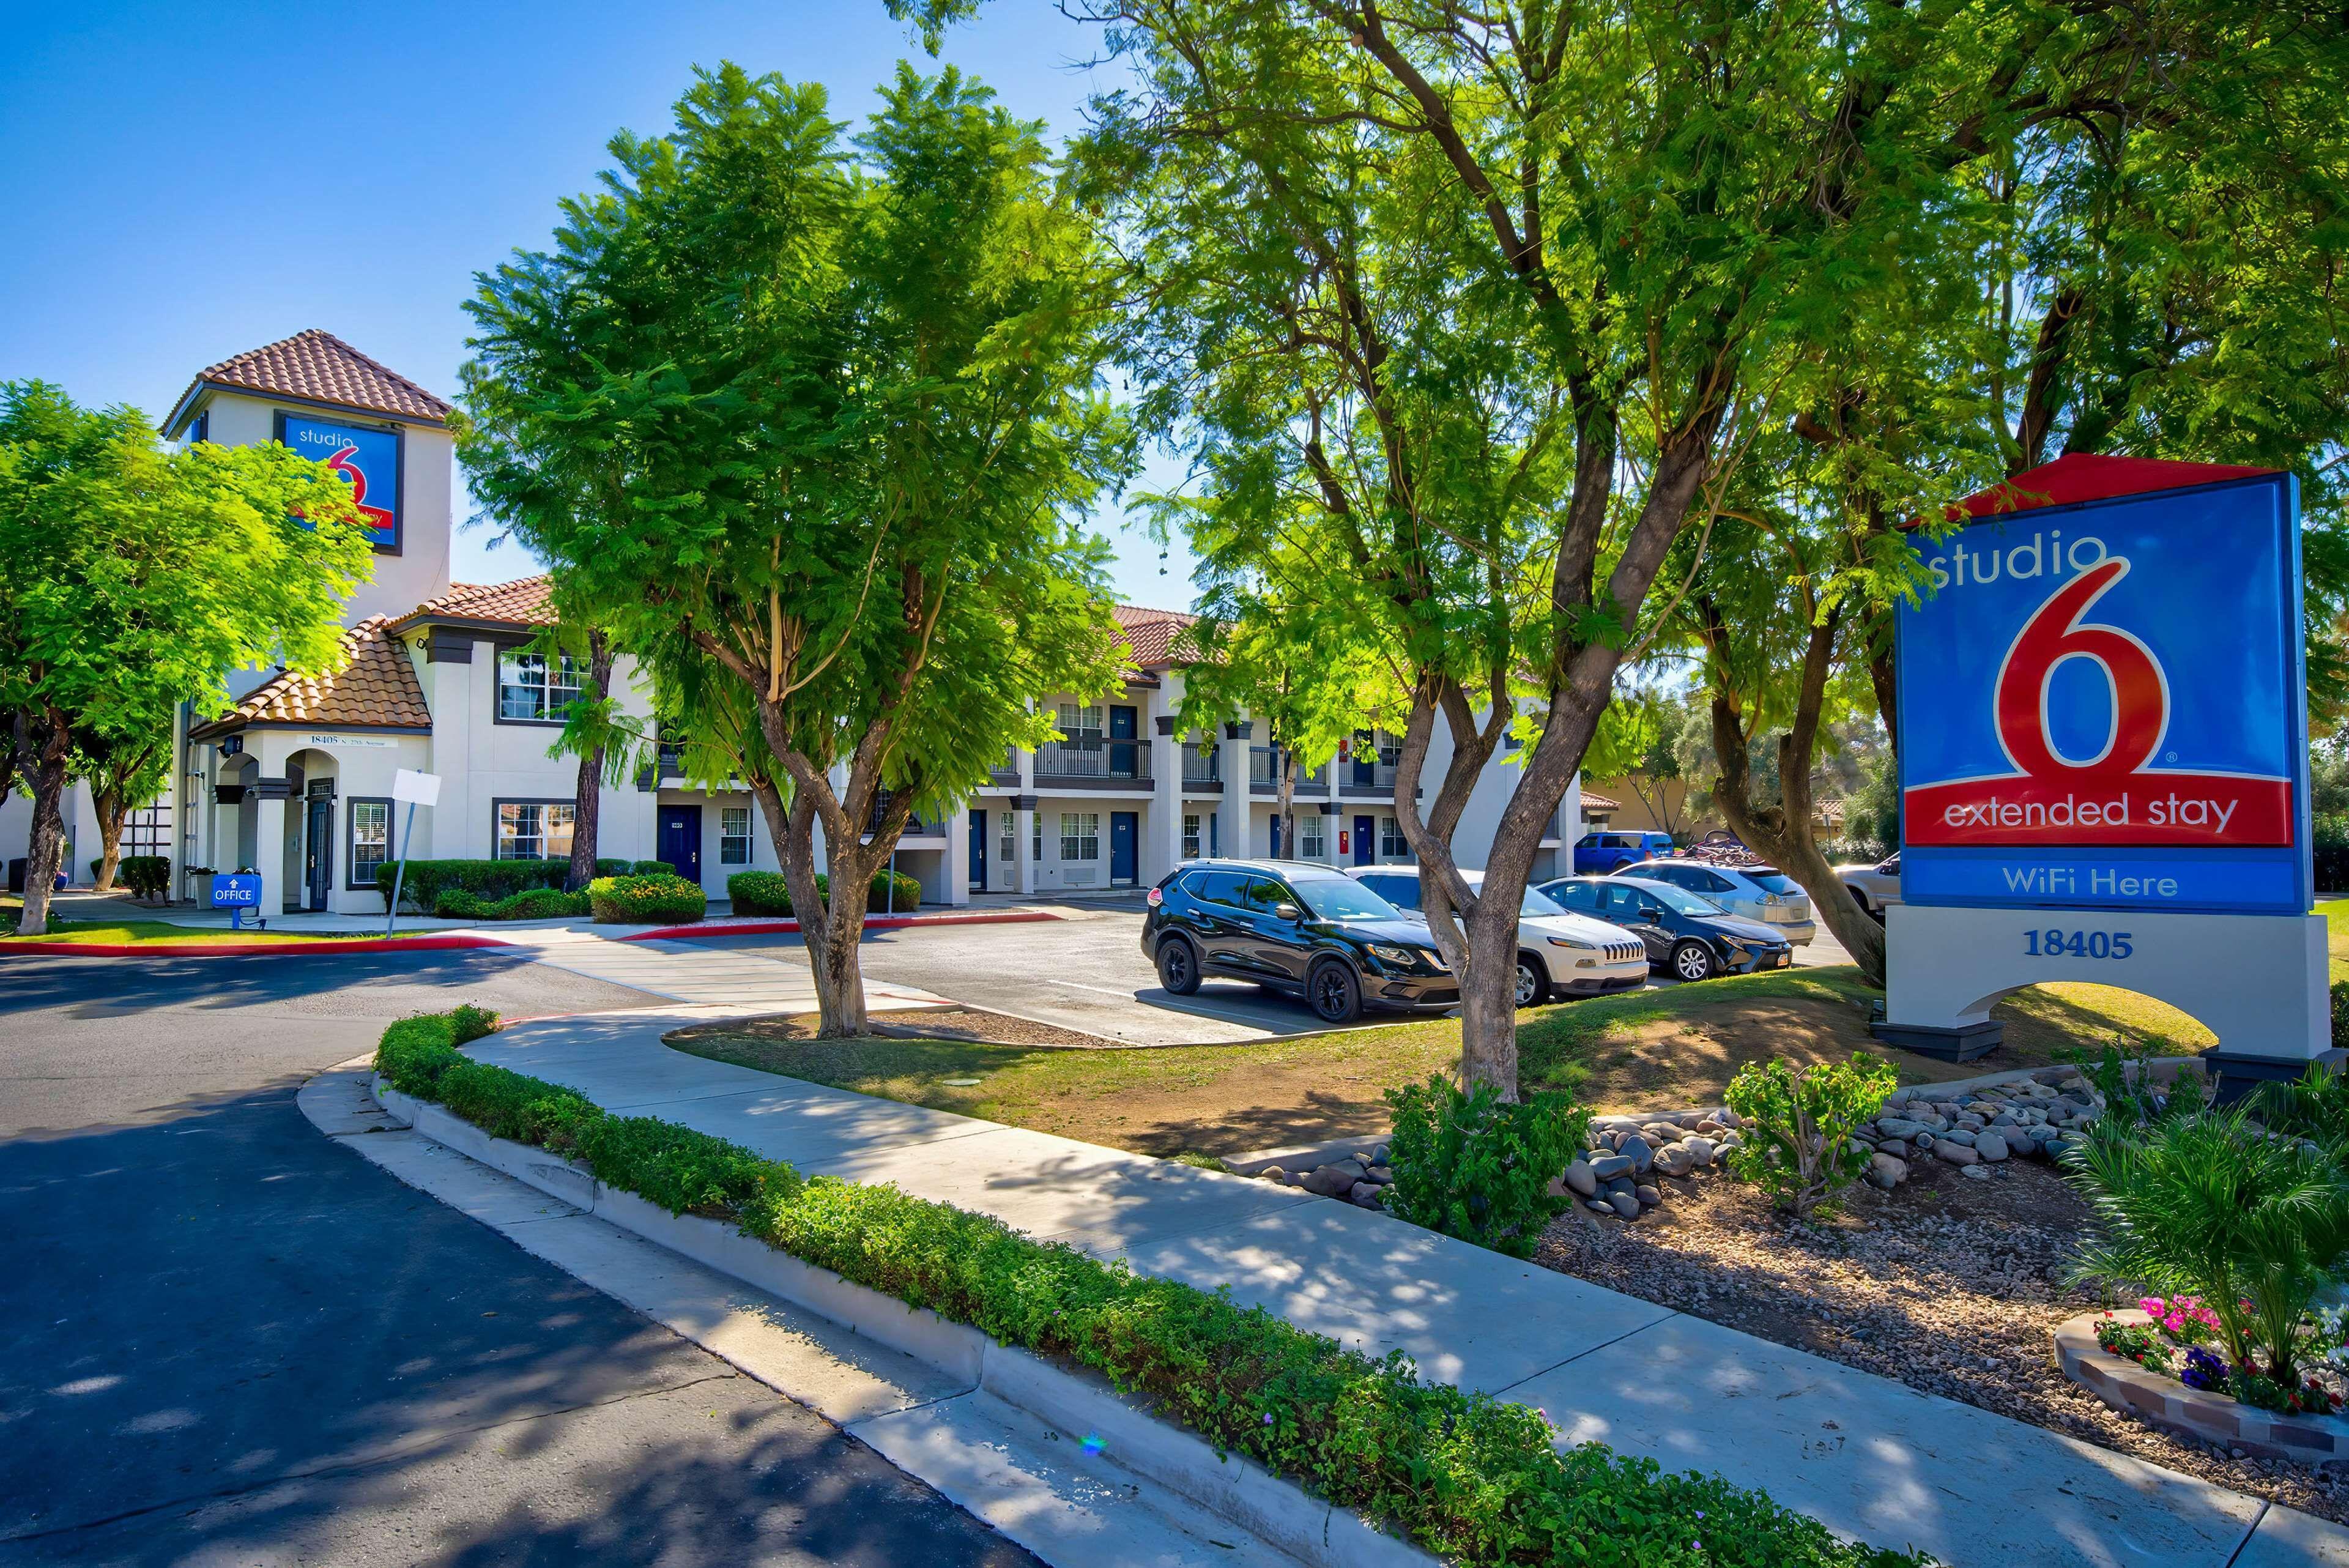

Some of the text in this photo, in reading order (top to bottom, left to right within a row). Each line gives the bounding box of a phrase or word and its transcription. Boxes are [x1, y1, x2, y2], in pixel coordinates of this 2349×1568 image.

[300, 429, 354, 447] studio
[1929, 530, 2107, 589] studio
[1993, 555, 2171, 777] 6
[1945, 793, 2239, 833] extended stay
[215, 890, 252, 901] OFFICE
[2002, 867, 2178, 897] WiFi Here
[2022, 929, 2133, 959] 18405
